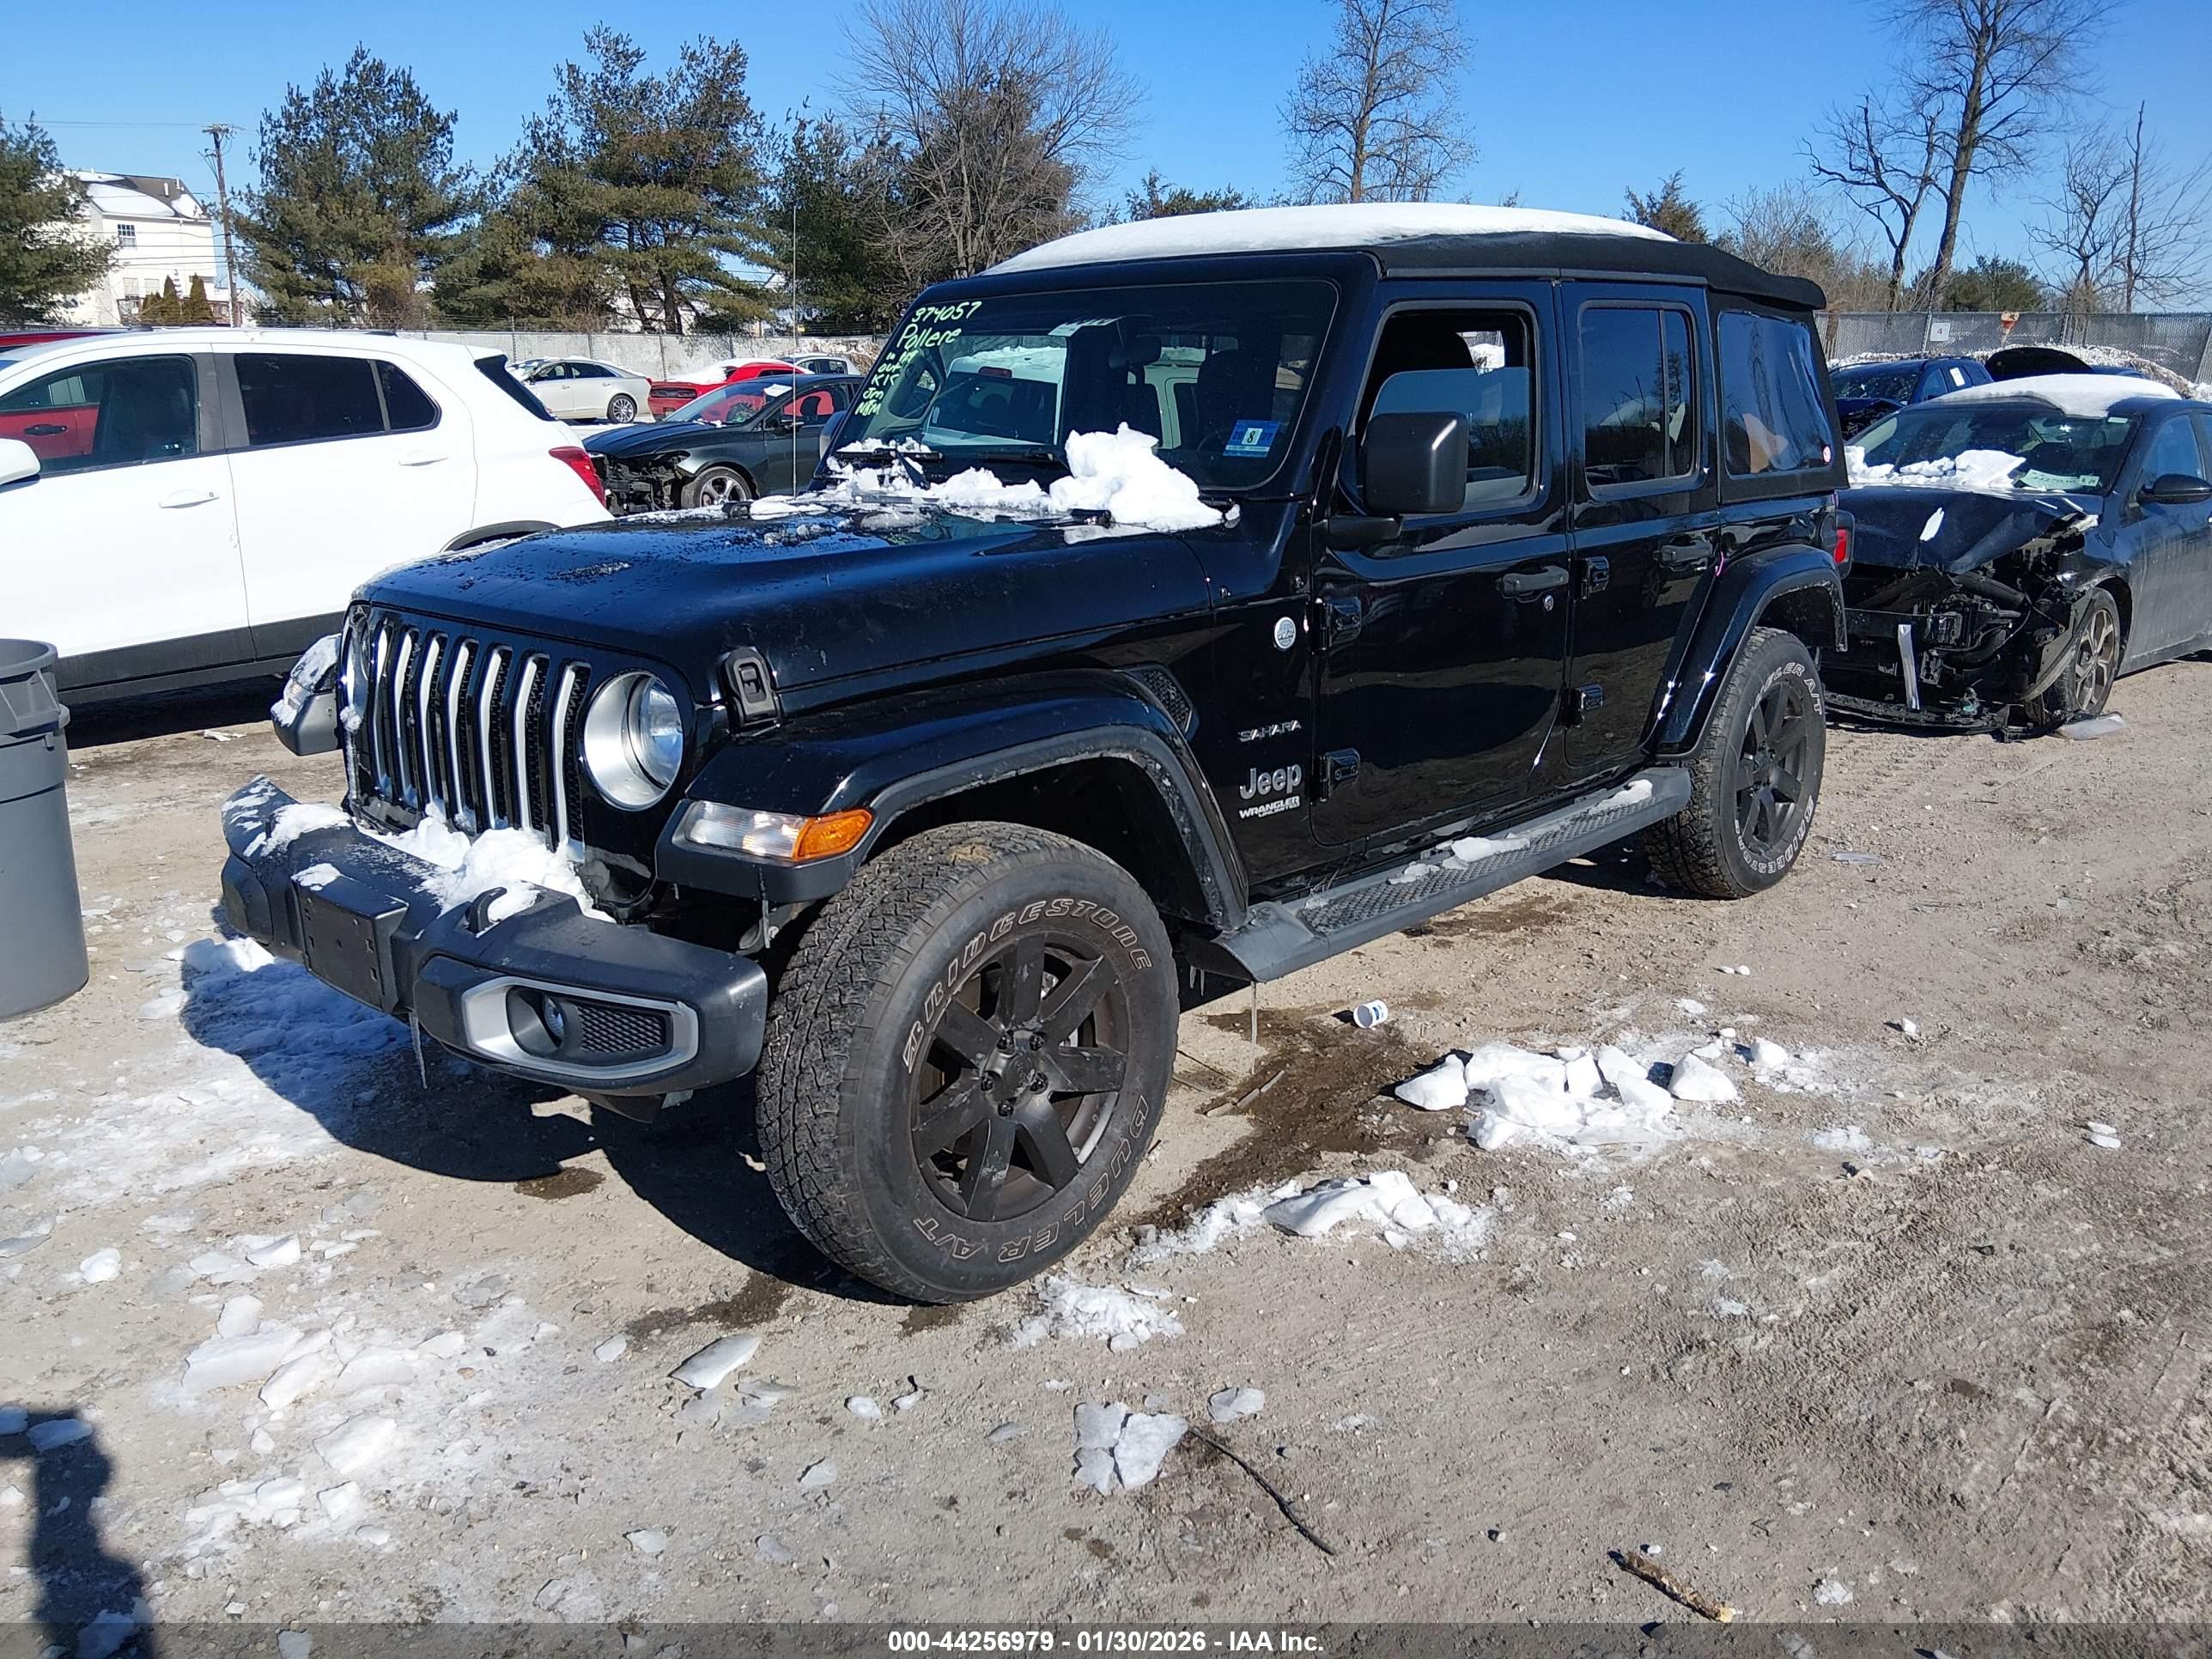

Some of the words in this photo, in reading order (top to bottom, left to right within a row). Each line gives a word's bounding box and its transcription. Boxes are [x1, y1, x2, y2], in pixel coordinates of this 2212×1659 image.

[911, 301, 982, 324] 374057
[1246, 430, 1256, 444] 8
[1237, 720, 1303, 743] SAHARA
[1239, 763, 1303, 800] Jeep
[1239, 795, 1301, 819] WRANGLER
[902, 898, 1152, 1074] BRIDGESTONE
[997, 1094, 1150, 1263] DUELER
[912, 1217, 984, 1260] A/T
